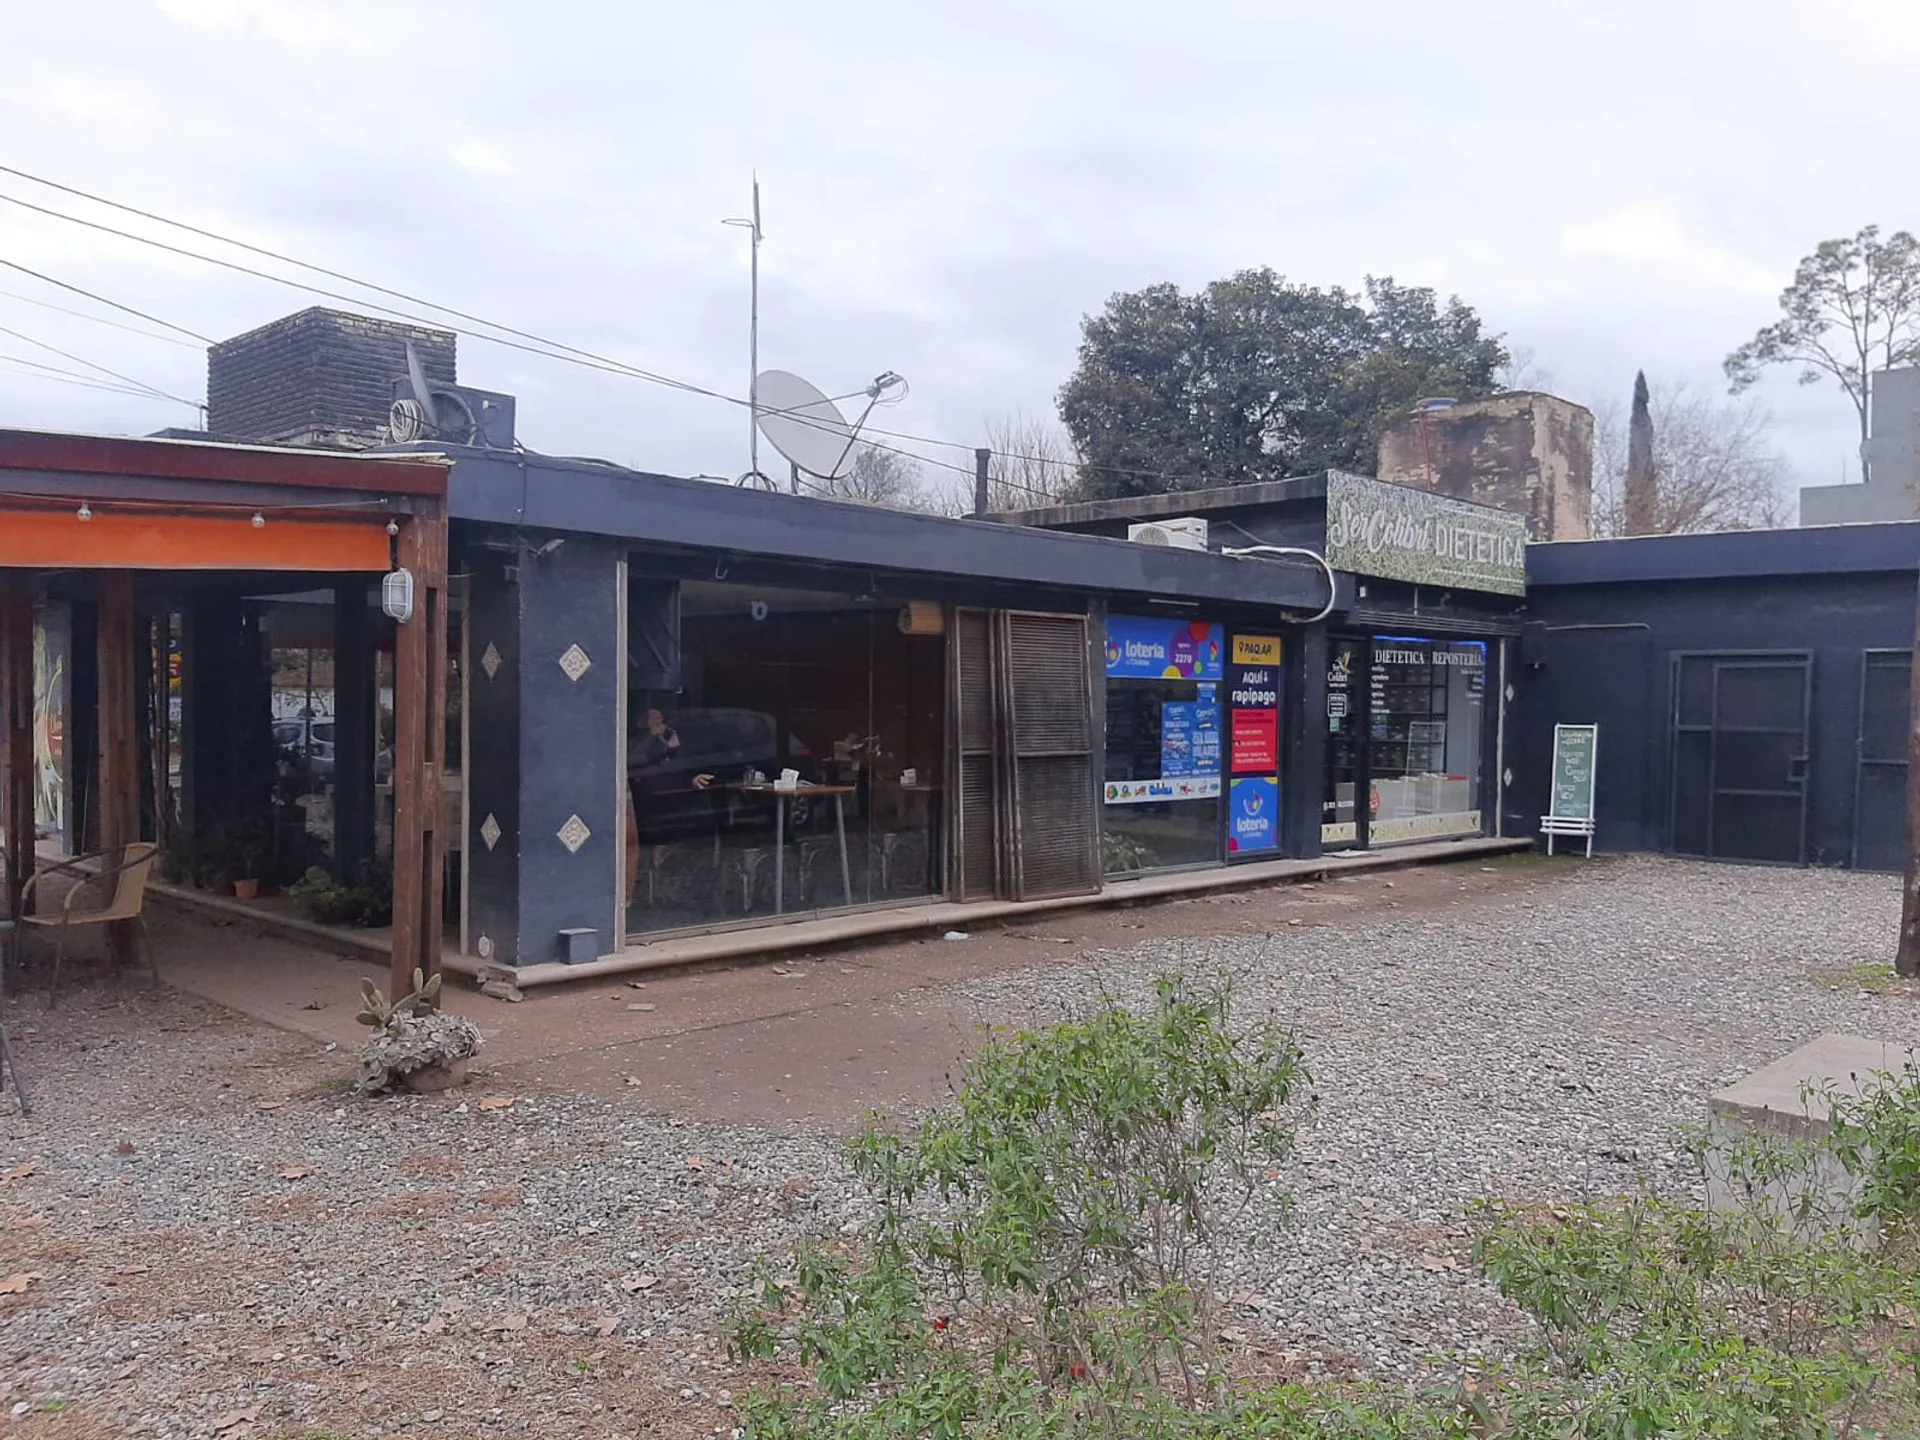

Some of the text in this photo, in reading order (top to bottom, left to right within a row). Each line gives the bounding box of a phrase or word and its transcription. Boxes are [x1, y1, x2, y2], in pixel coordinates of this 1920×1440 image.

[1331, 501, 1368, 547] Ser
[1435, 523, 1525, 569] DIETETICA
[1375, 650, 1426, 664] DIETETICA
[1232, 686, 1276, 705] rapipago
